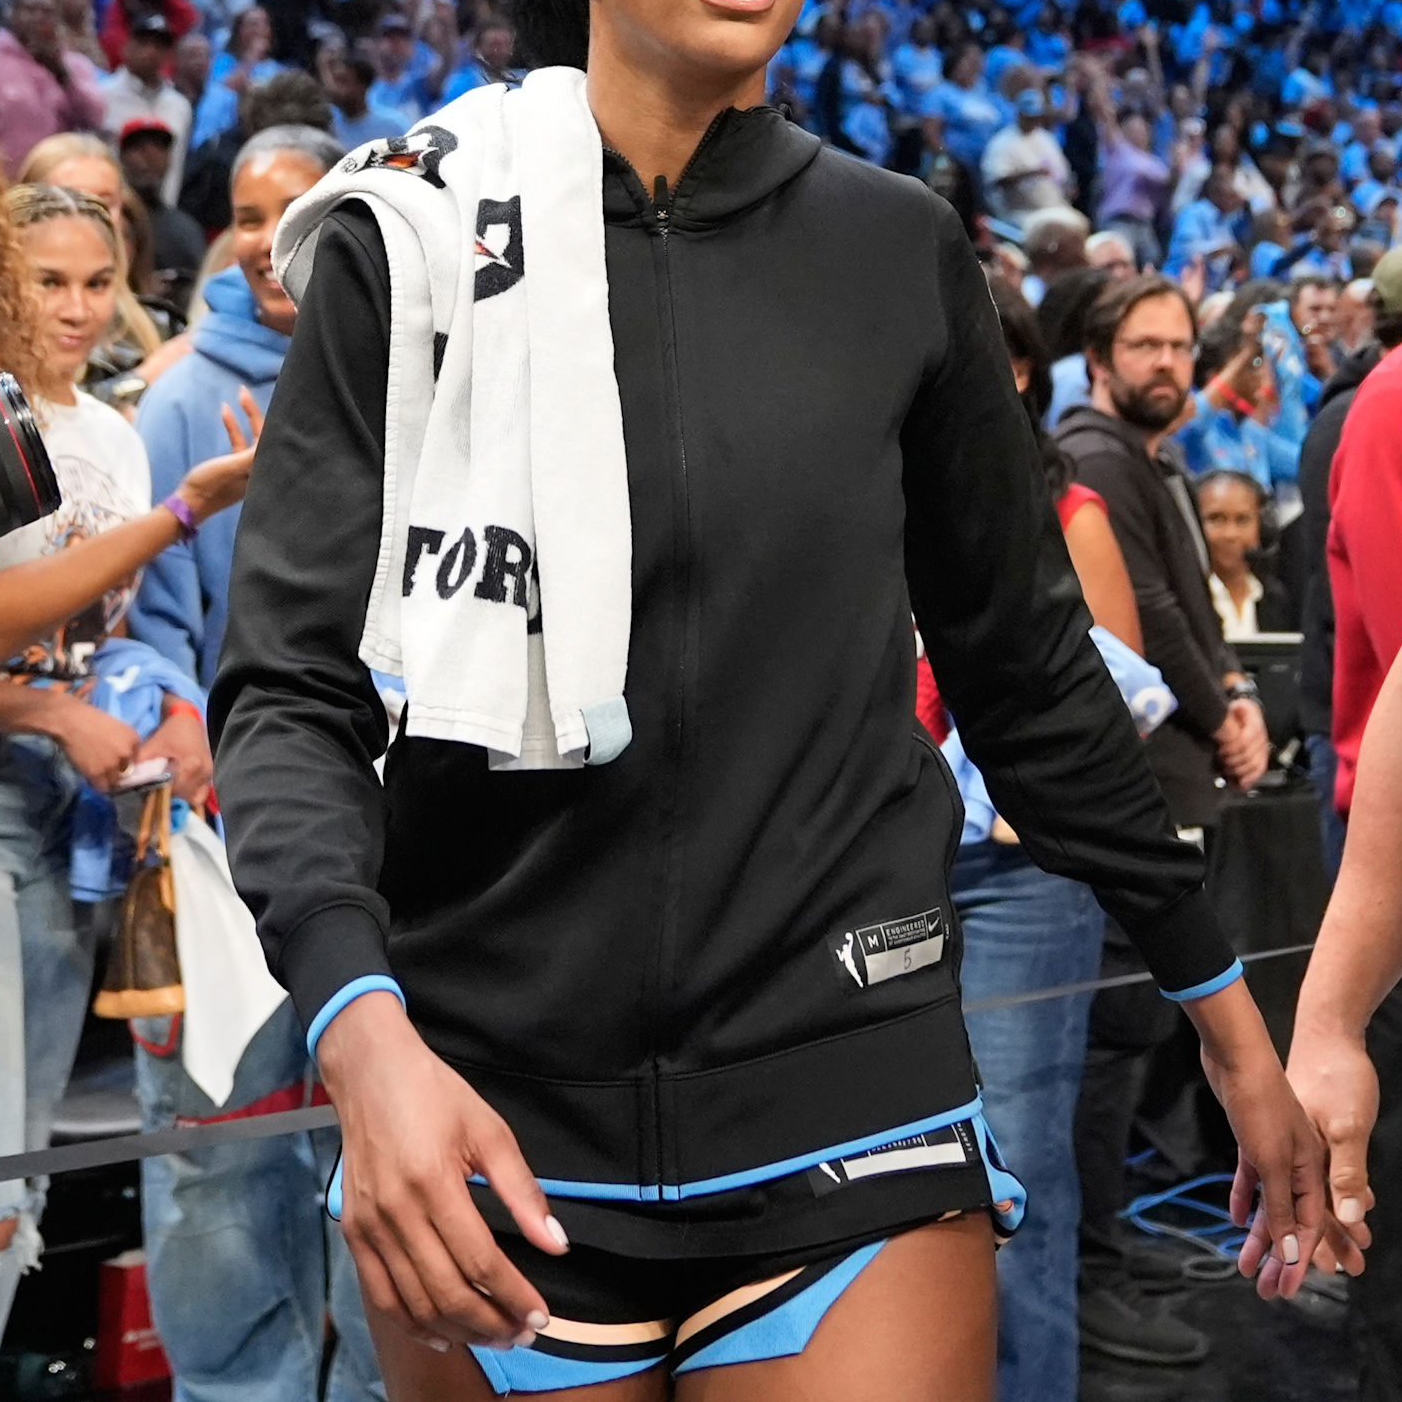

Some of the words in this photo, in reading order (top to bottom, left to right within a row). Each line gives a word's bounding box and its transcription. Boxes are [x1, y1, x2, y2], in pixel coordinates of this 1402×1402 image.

[402, 525, 542, 634] TOR
[885, 919, 925, 937] ENGINEERED
[867, 934, 879, 948] M
[903, 948, 912, 970] 5
